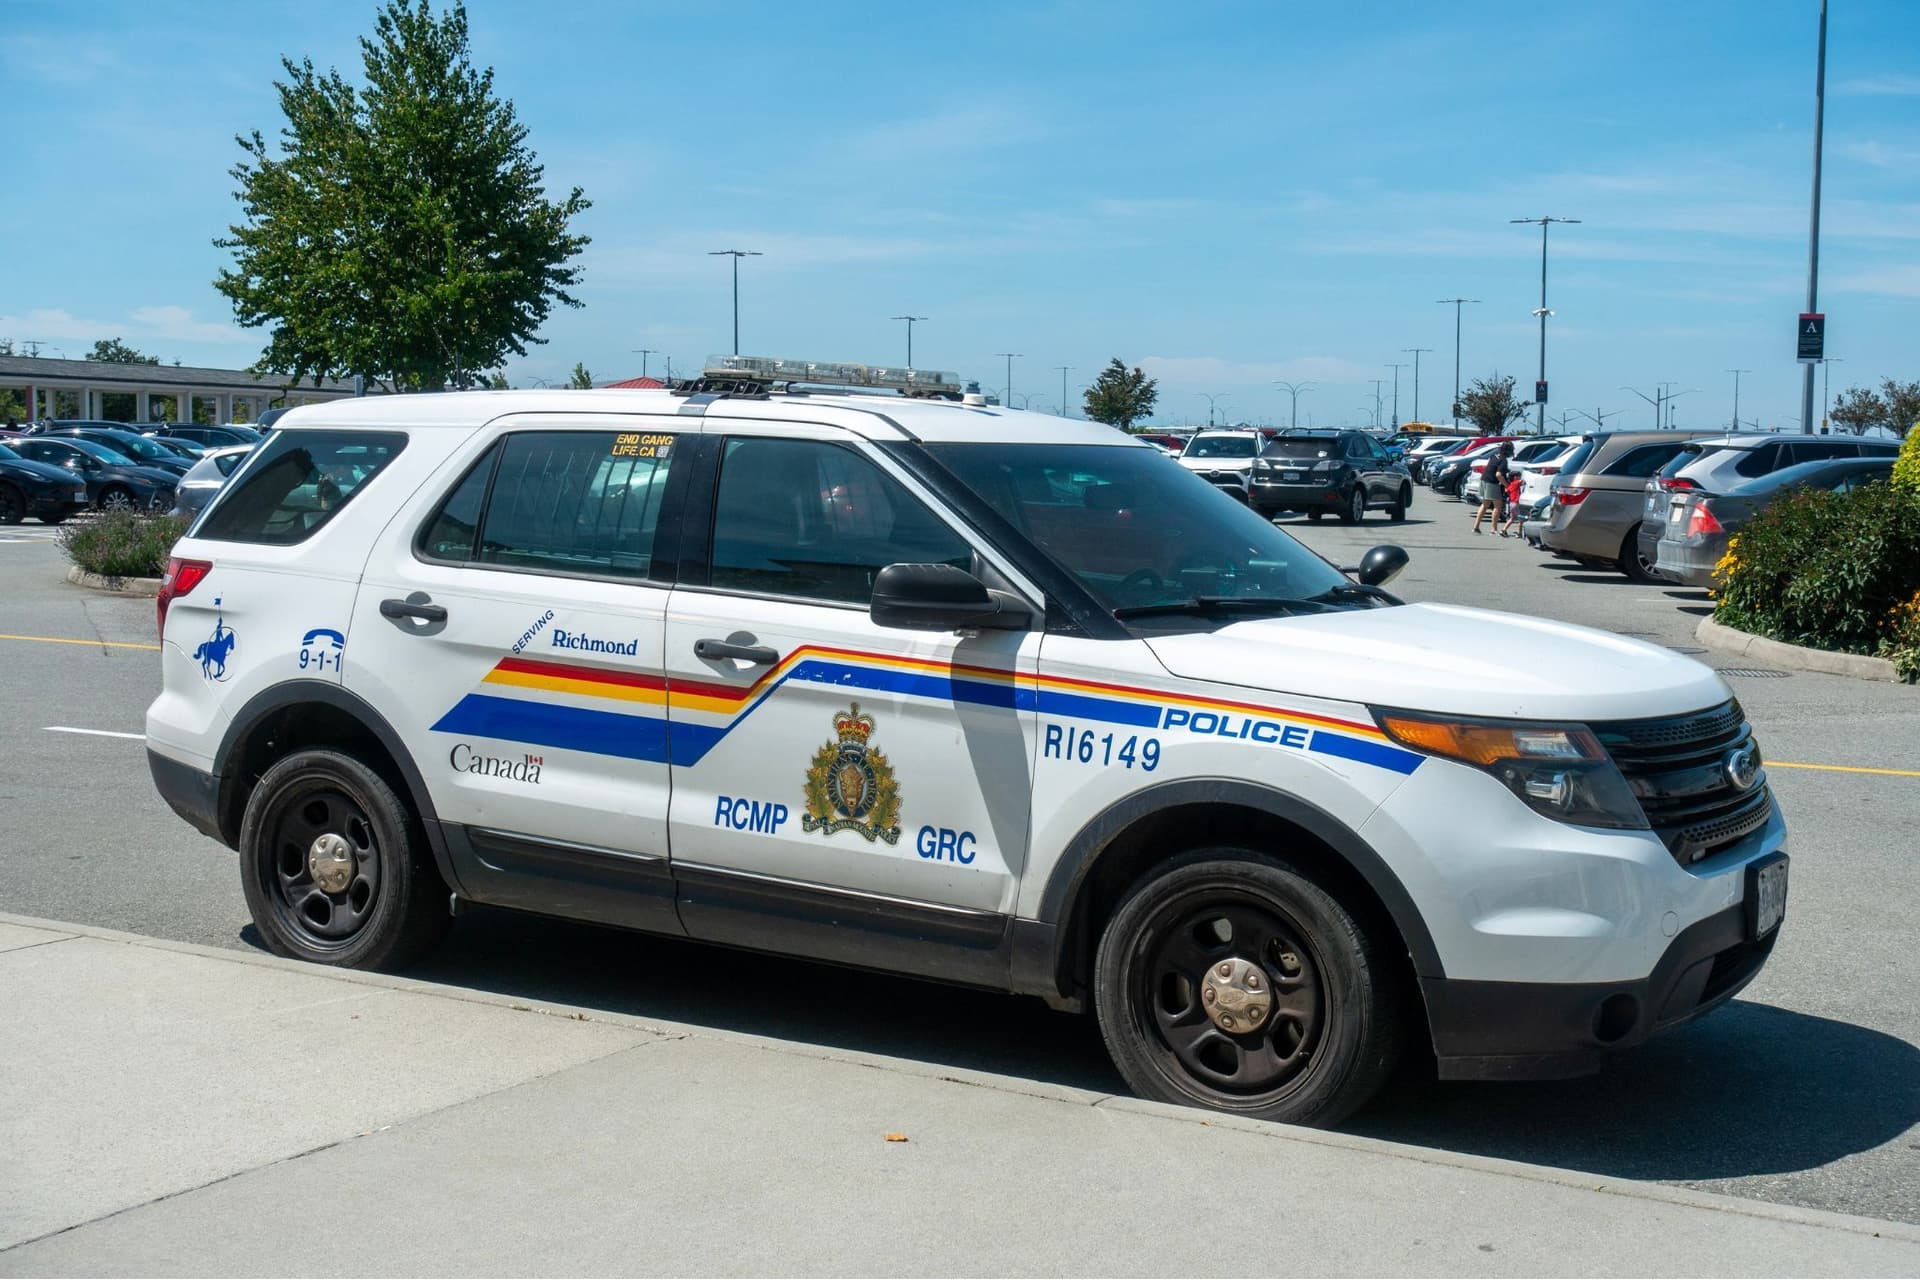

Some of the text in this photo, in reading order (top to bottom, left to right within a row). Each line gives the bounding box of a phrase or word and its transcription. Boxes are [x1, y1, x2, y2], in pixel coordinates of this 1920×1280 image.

[1806, 321, 1817, 333] A
[612, 444, 655, 457] LIFE.CA
[616, 434, 674, 446] END GANG
[512, 609, 554, 655] SERVING
[552, 629, 639, 656] Richmond
[299, 649, 341, 672] 9-1-1
[1044, 724, 1161, 771] RI6149
[1163, 708, 1310, 750] POLICE
[450, 743, 542, 784] Canada
[714, 796, 789, 835] RCMP
[916, 825, 977, 865] GRC
